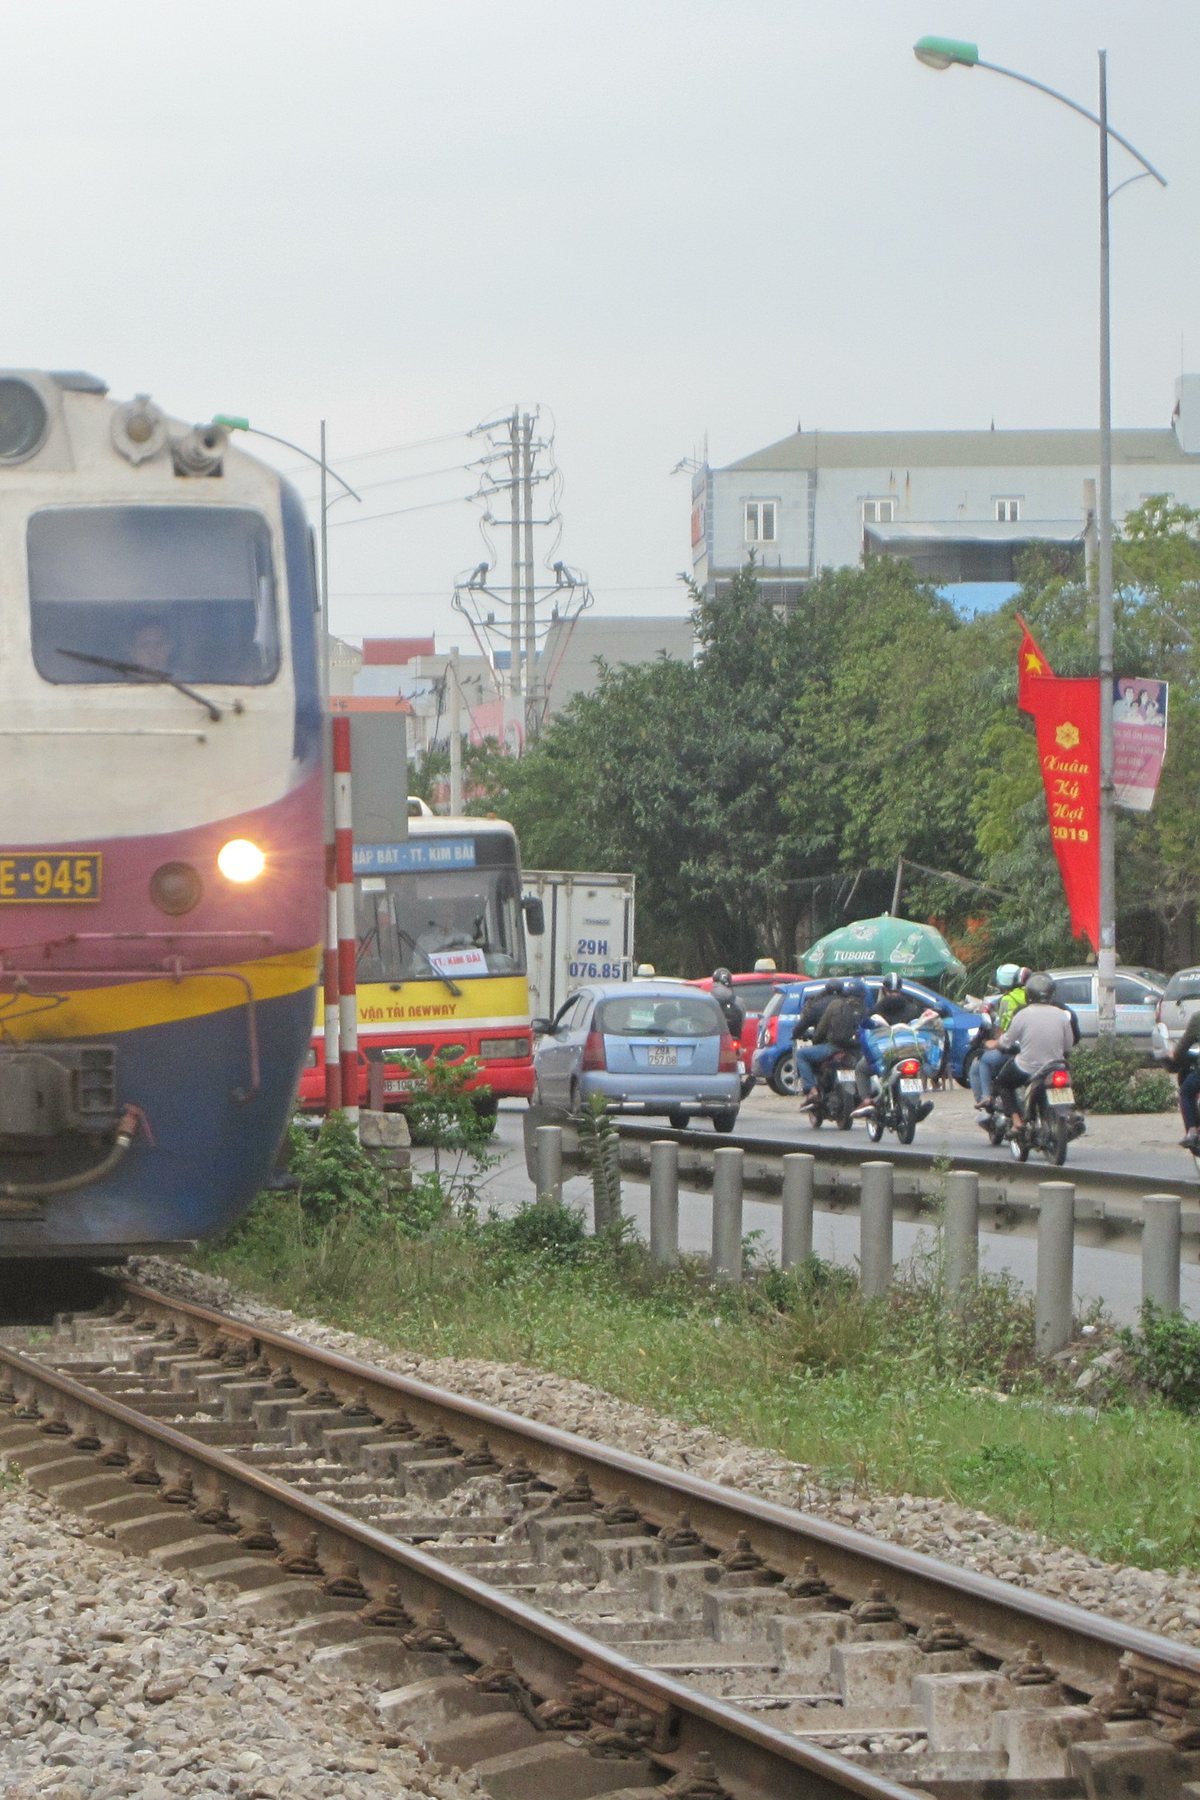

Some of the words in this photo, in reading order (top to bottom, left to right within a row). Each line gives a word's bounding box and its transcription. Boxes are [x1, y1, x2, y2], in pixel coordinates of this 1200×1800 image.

[1043, 754, 1089, 774] Xuân
[1052, 802, 1084, 823] Hợi
[428, 846, 452, 861] KIM
[577, 939, 609, 956] 29H
[833, 950, 876, 961] TUBORG
[569, 962, 621, 979] 076.85
